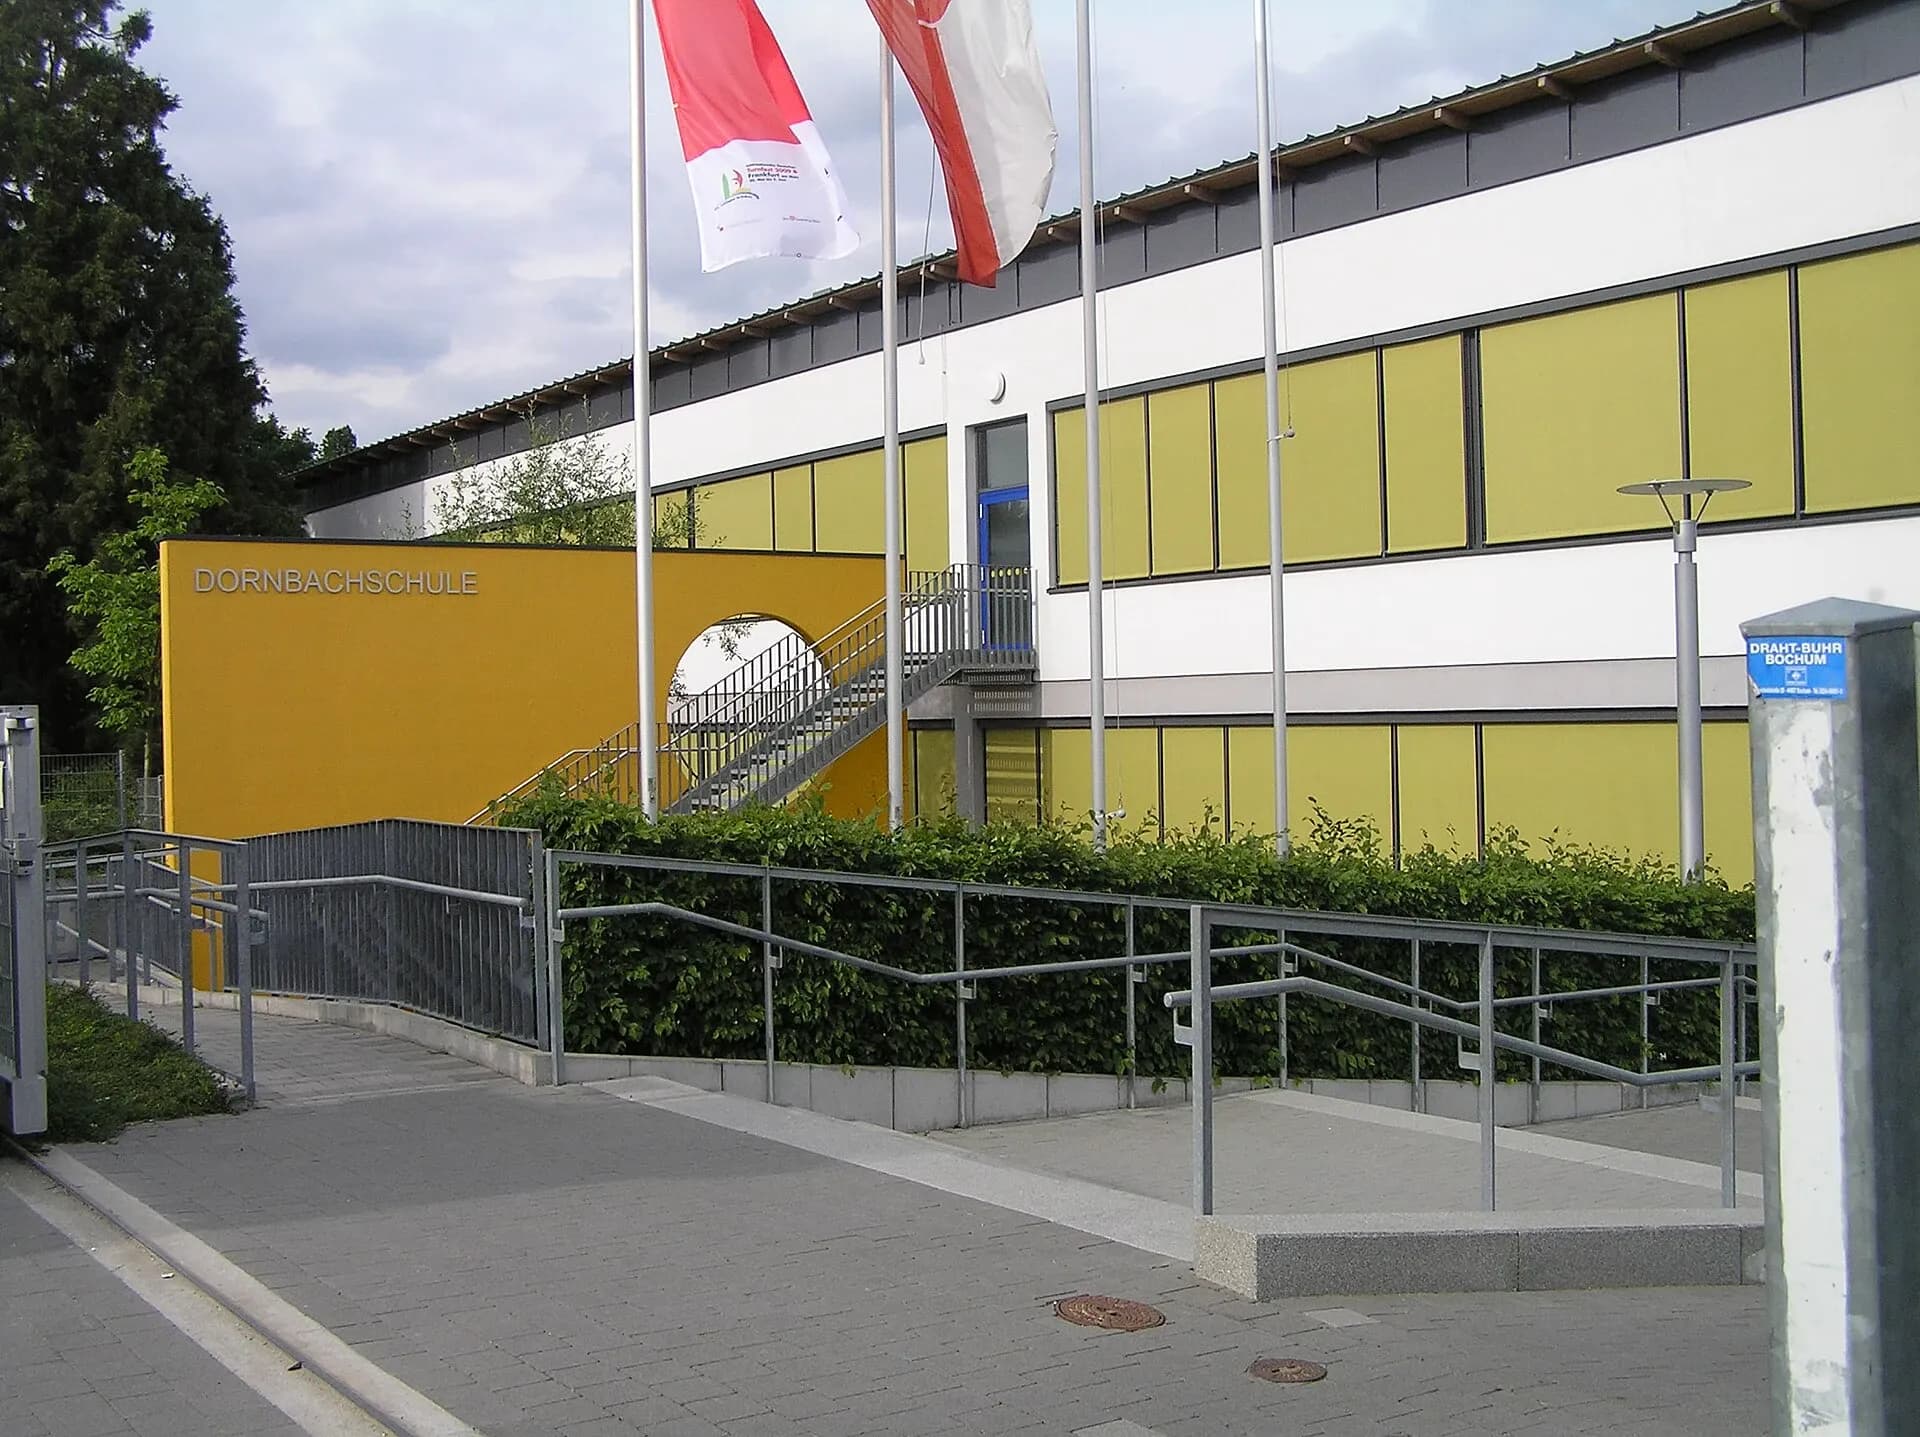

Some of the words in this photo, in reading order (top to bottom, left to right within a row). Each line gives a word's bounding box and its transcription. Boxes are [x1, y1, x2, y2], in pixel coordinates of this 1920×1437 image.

[194, 569, 477, 595] DORNBACHSCHULE
[1750, 643, 1842, 653] DRAHT-BUHR
[1765, 654, 1827, 665] BOCHUM
